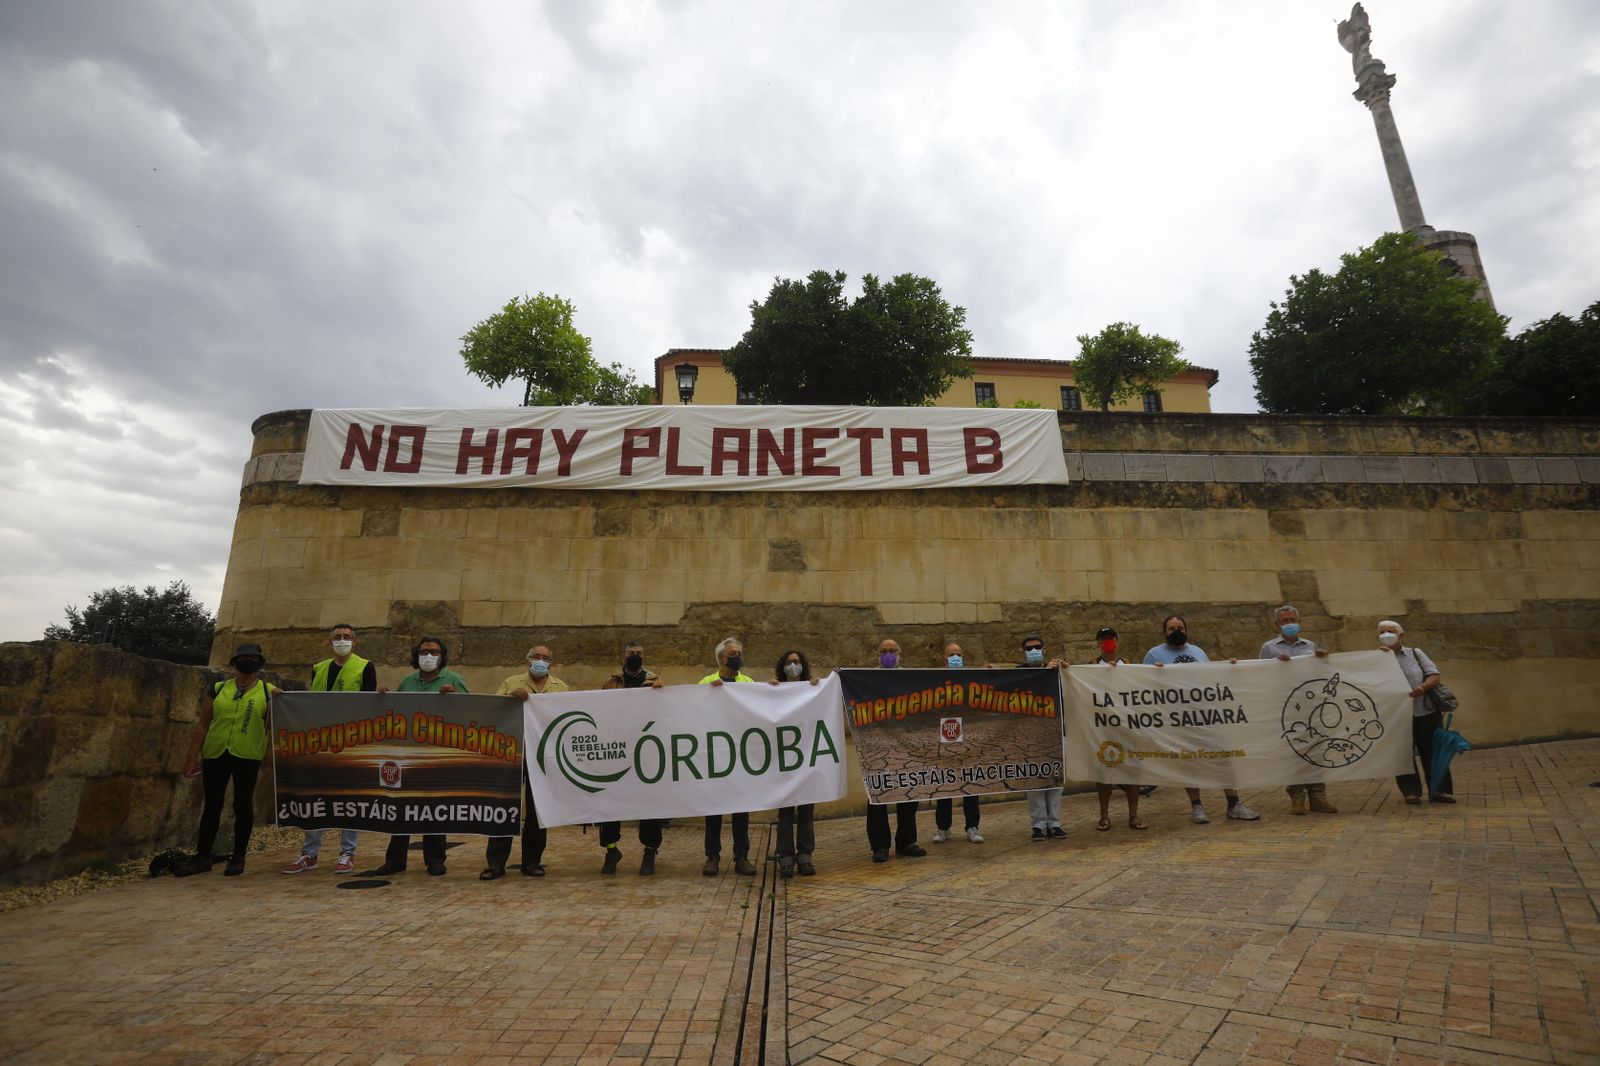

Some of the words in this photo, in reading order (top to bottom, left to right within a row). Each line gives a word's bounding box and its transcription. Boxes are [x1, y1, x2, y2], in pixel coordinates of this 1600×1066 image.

[340, 423, 427, 473] NO
[455, 428, 588, 475] HAY
[619, 427, 930, 476] PLANETA
[963, 427, 1004, 474] B
[968, 681, 1056, 719] Climática
[1092, 692, 1114, 708] LA
[1119, 683, 1234, 707] TECNOLOGÍA
[943, 722, 960, 731] STOP
[1127, 712, 1164, 729] NOS
[1169, 705, 1248, 727] SALVARÁ
[278, 709, 407, 759] Emergencia
[412, 711, 517, 763] Climática
[571, 734, 598, 744] 2020
[572, 741, 626, 752] REBELIÓN
[587, 750, 627, 761] CLIMA
[383, 765, 398, 774] STOP
[899, 766, 957, 789] ESTÁIS
[962, 761, 1062, 784] HACIENDO?
[278, 798, 326, 820] ¿QUÉ
[333, 799, 397, 821] ESTÁIS
[405, 804, 519, 824] HACIENDO?
